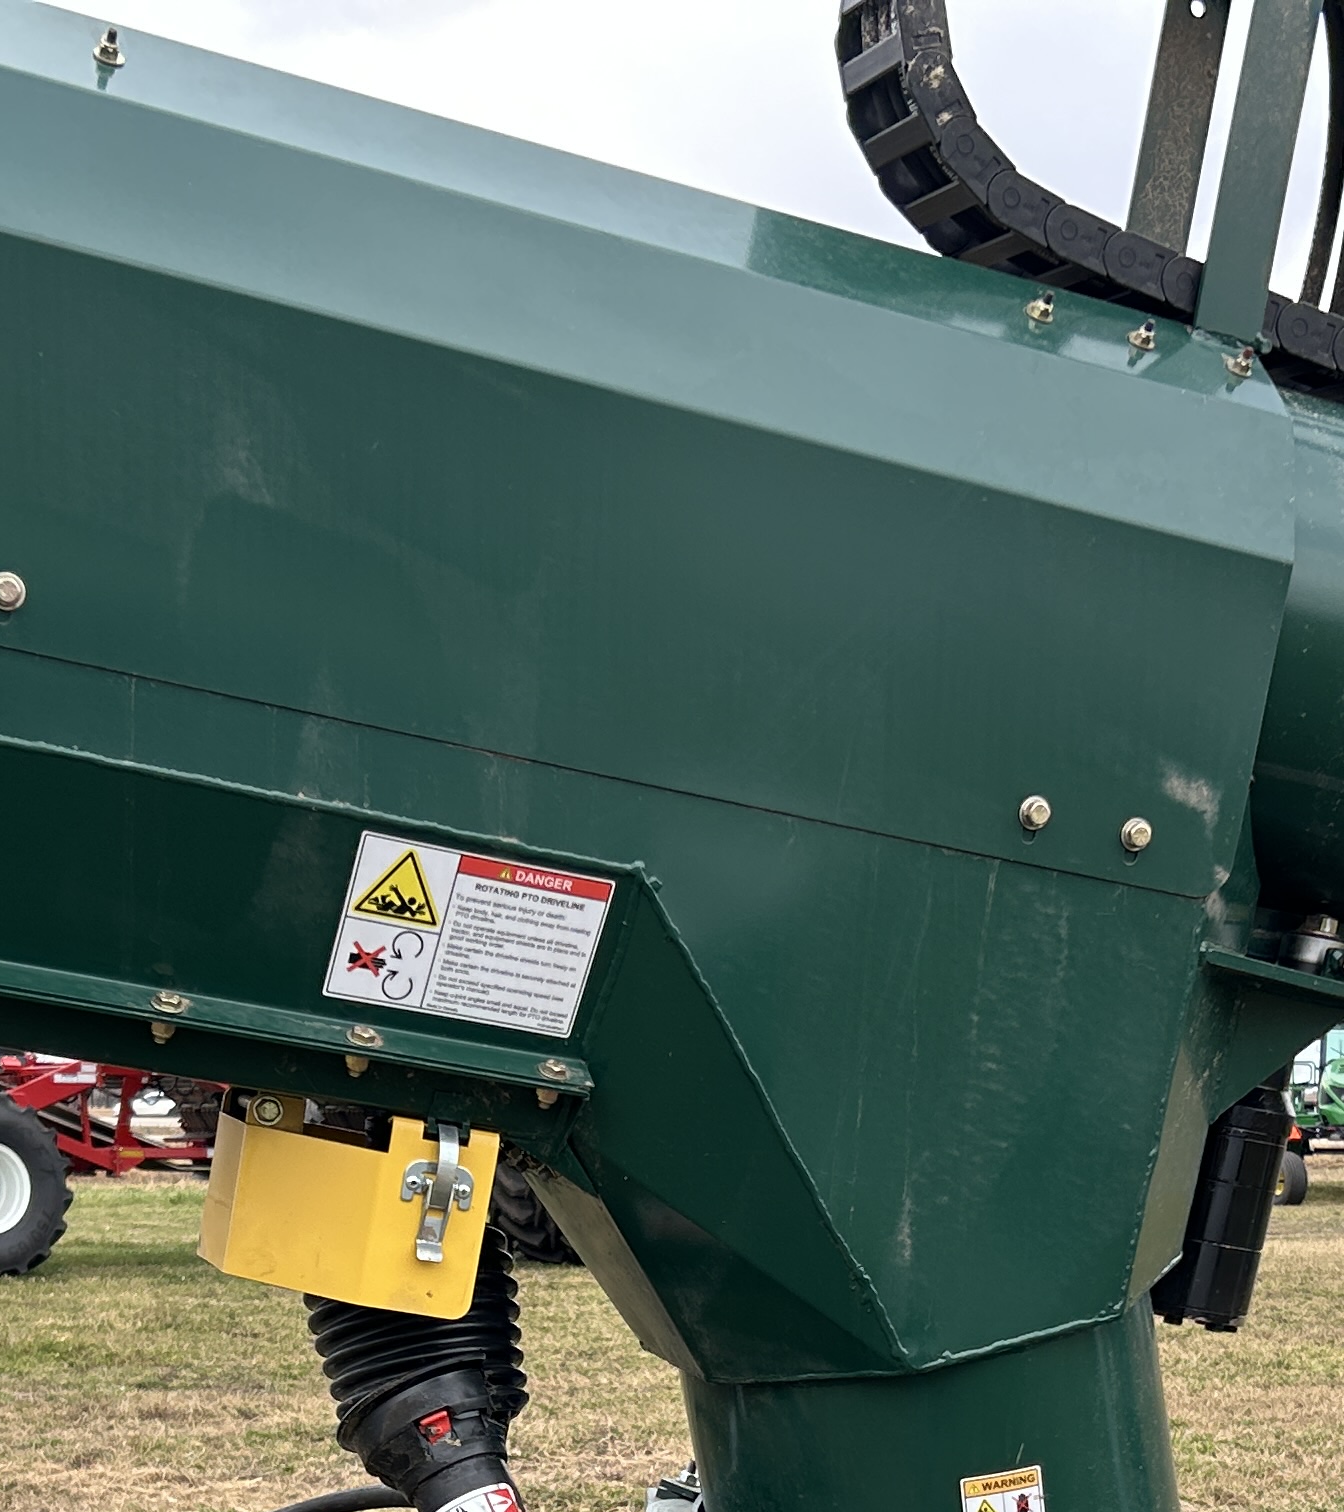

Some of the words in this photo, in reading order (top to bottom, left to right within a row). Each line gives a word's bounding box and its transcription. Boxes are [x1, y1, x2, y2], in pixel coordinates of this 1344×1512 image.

[514, 870, 573, 891] DANGER
[474, 883, 520, 898] ROTATING
[521, 892, 539, 902] PTO
[540, 896, 585, 911] DRIVELINE
[982, 1474, 1035, 1491] WARNING
